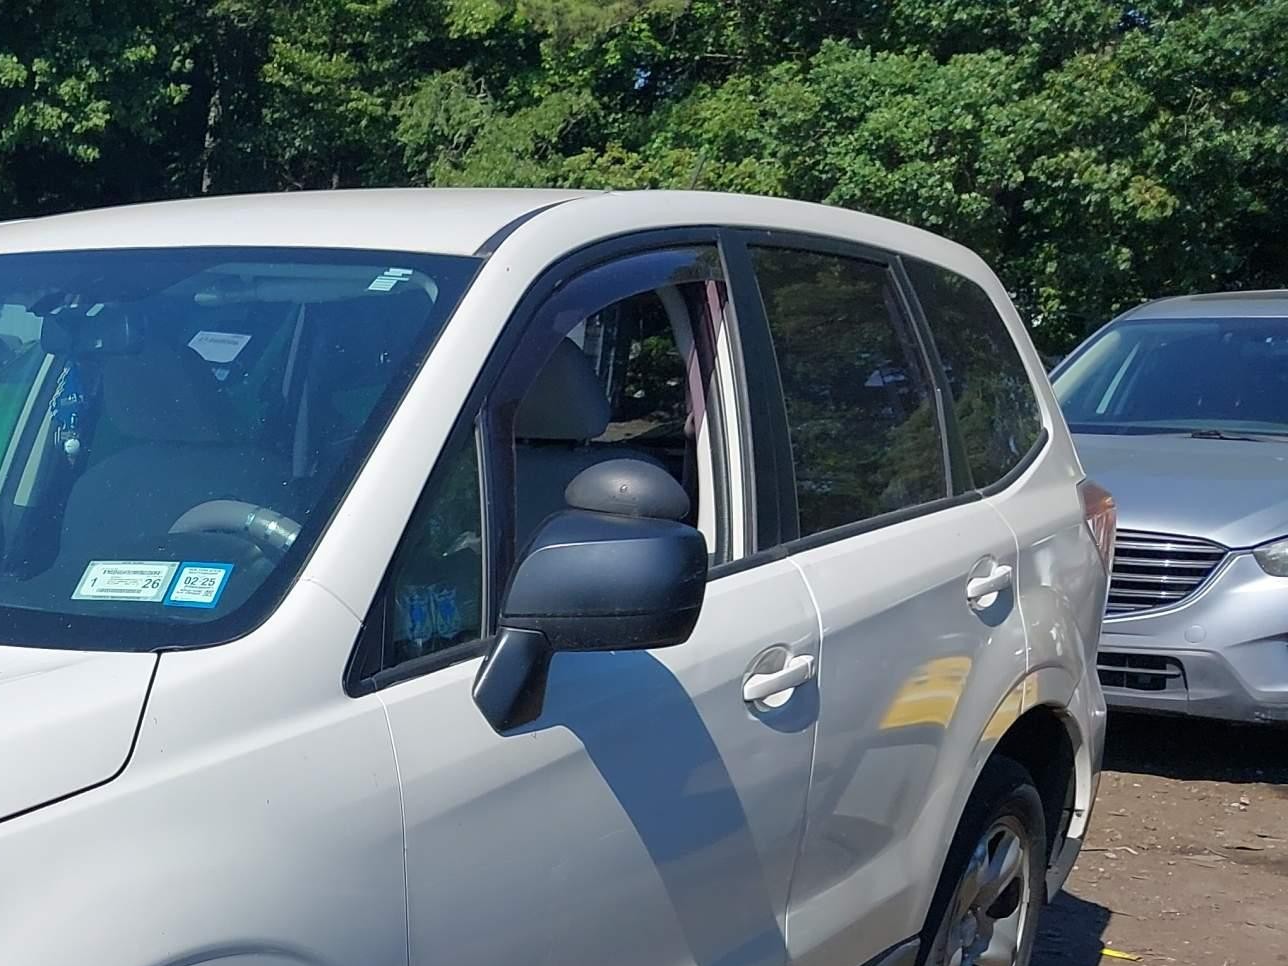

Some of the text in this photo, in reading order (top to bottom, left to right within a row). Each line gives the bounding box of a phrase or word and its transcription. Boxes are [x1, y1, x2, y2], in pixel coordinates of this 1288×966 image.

[141, 578, 161, 589] 26
[184, 576, 216, 587] 02 25
